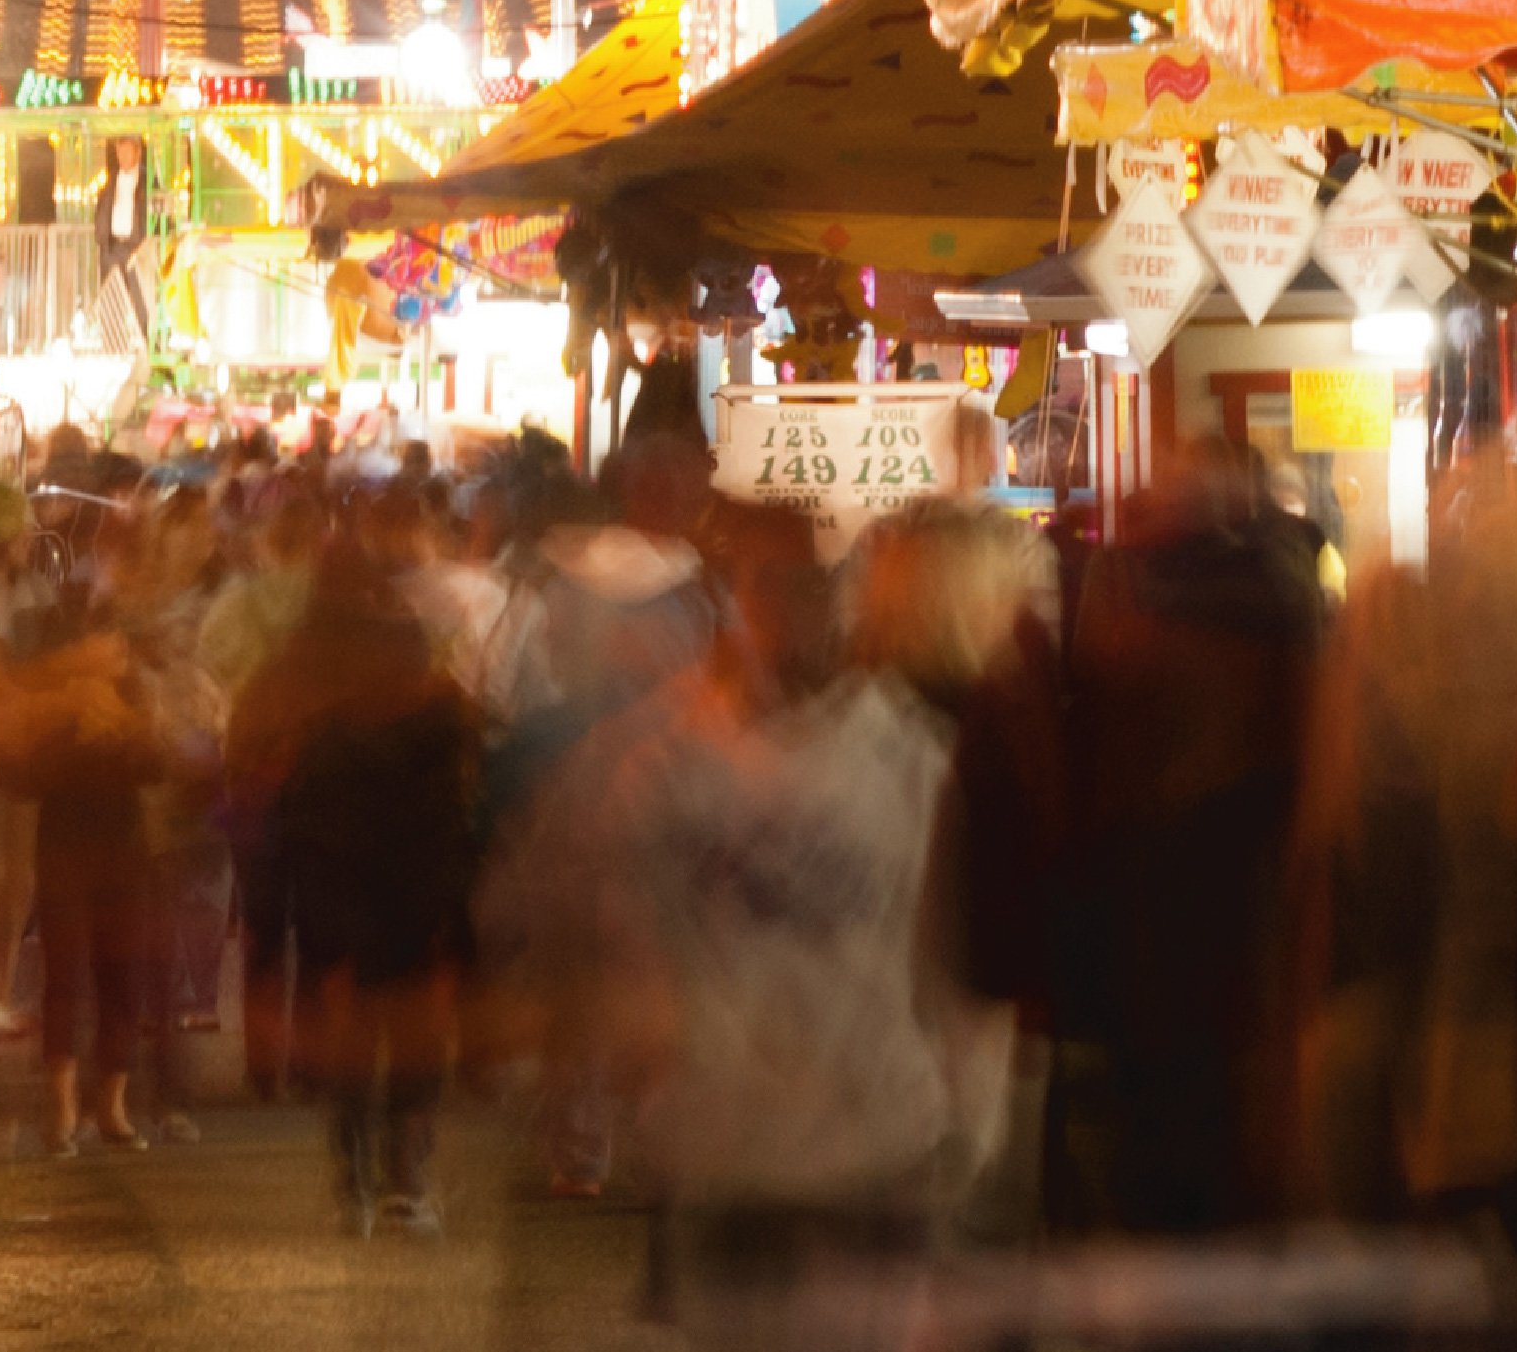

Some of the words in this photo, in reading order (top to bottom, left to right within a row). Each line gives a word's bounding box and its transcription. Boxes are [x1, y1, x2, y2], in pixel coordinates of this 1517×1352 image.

[1397, 158, 1476, 188] WNNER
[760, 426, 828, 448] 125
[854, 426, 921, 448] 100
[753, 454, 838, 485] 149
[850, 454, 938, 485] 124
